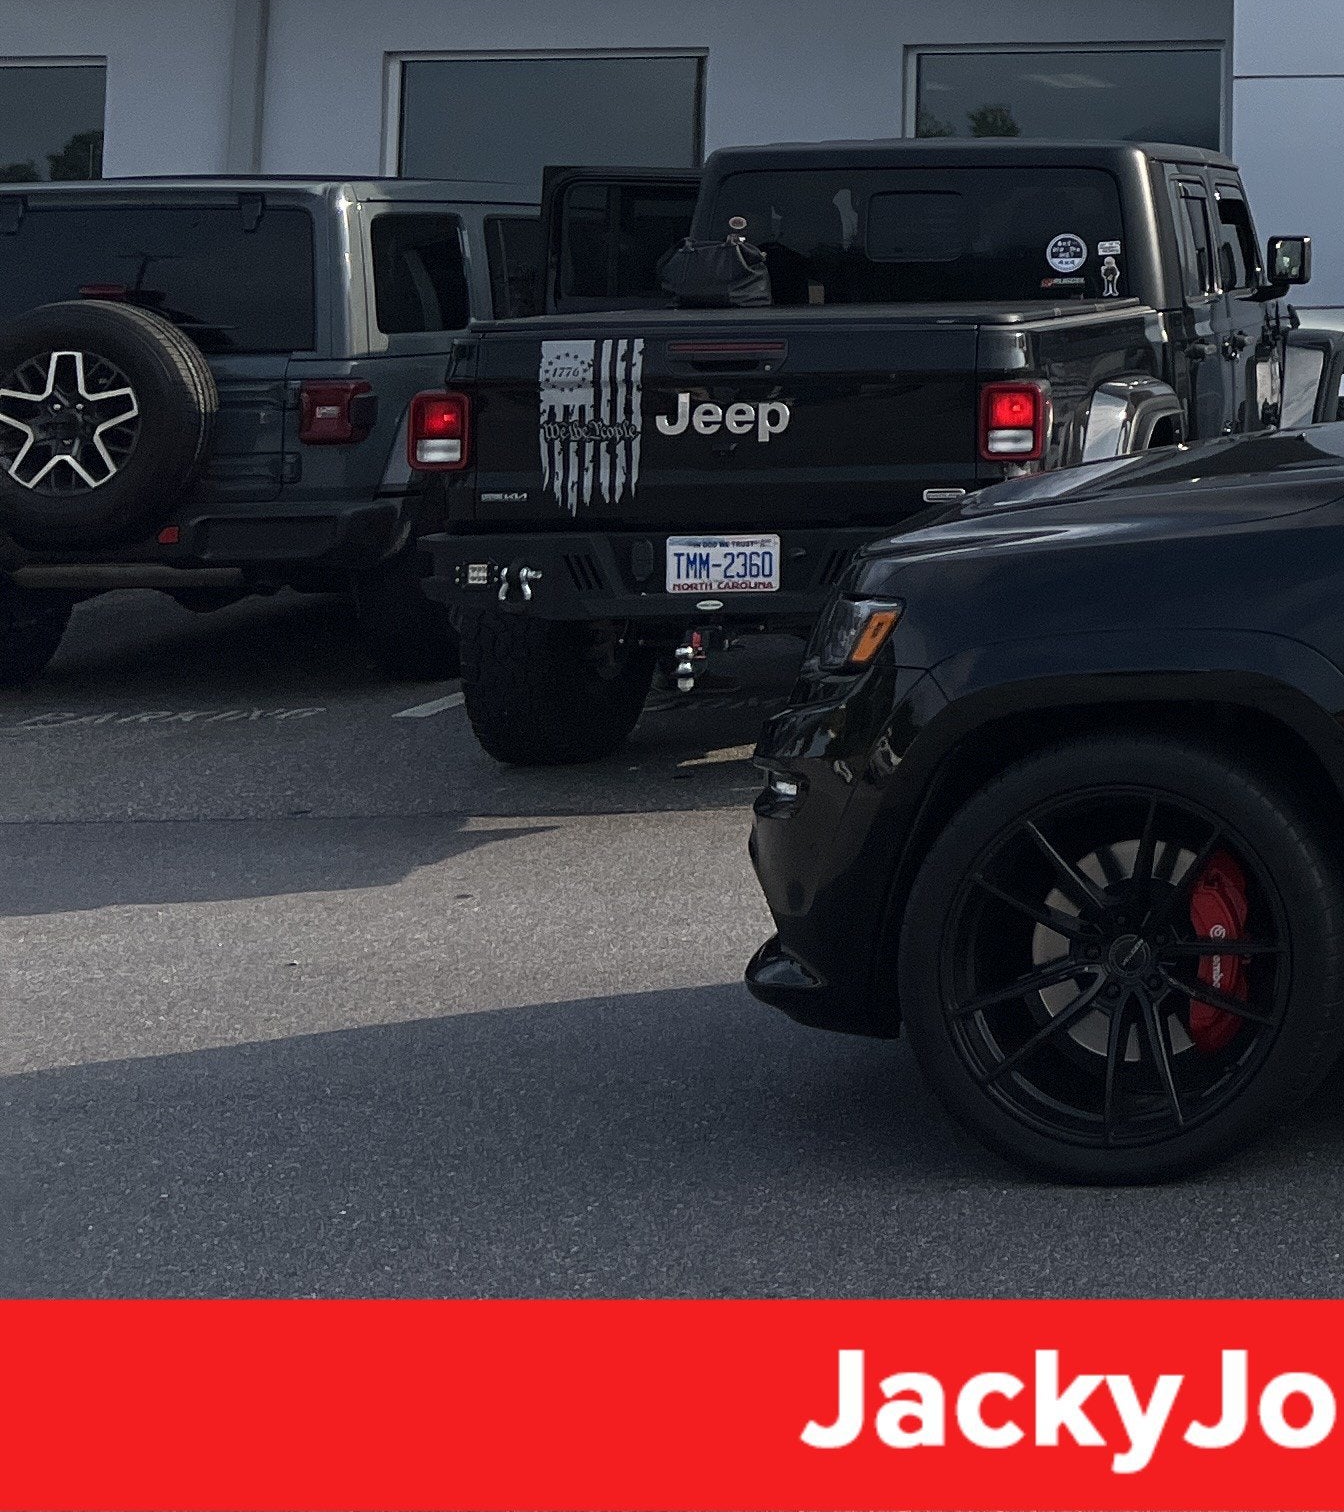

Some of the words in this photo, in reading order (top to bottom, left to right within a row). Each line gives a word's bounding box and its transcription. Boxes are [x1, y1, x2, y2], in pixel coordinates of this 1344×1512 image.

[552, 366, 580, 378] 1776
[655, 392, 790, 443] Jeep
[674, 551, 773, 580] TMM-2360
[672, 582, 713, 591] NORTH
[717, 581, 774, 590] CAROLINA
